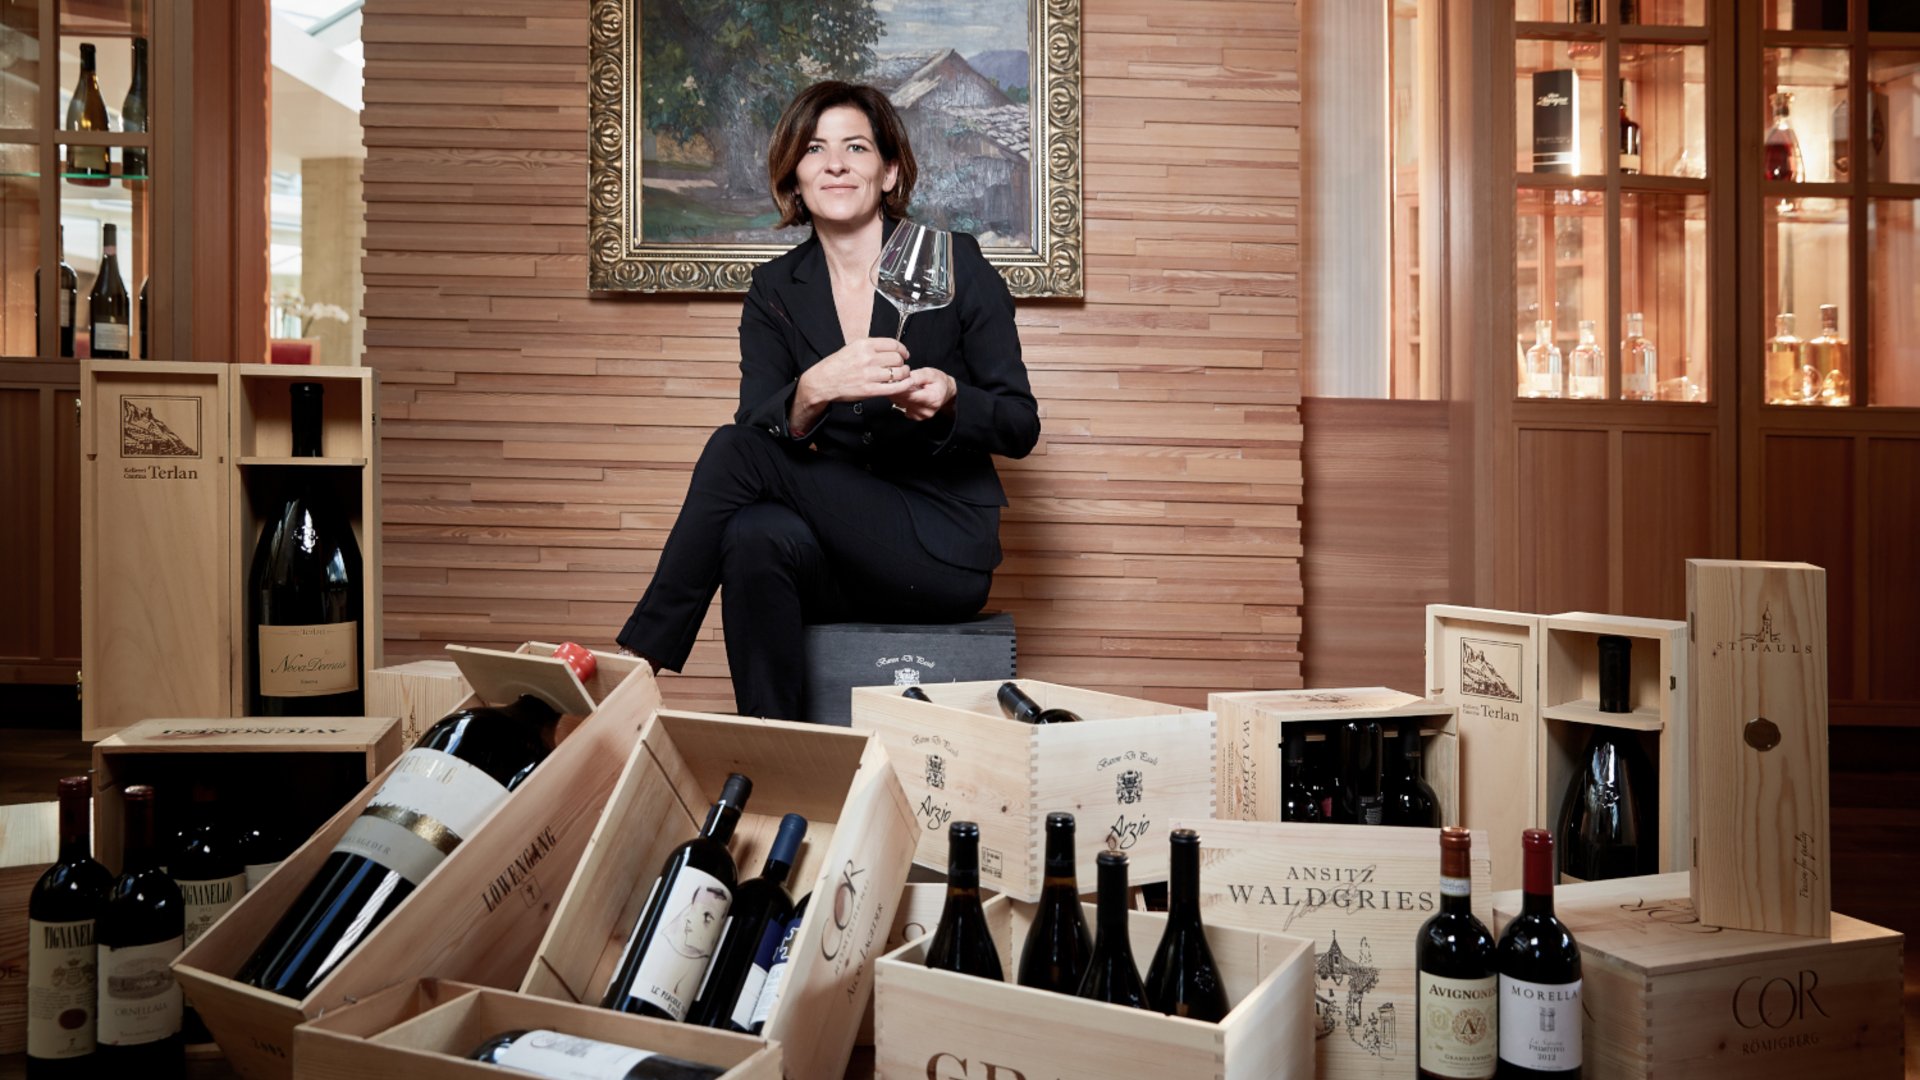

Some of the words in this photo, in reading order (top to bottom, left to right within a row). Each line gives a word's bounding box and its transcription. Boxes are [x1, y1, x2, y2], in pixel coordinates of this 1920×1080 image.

[148, 465, 198, 480] Terlan
[1480, 704, 1519, 722] Terlan
[1242, 720, 1250, 821] WALDGR
[917, 794, 952, 830] Arzio
[1105, 813, 1150, 850] Arzio
[481, 825, 557, 913] LÖWENGANG
[1285, 865, 1375, 883] ANSITZ
[821, 859, 865, 961] COR
[1227, 884, 1435, 912] WALDGRIES
[1428, 983, 1497, 1001] AVIGNONES
[1511, 985, 1579, 1001] MORELLA
[1732, 969, 1831, 1030] COR
[1741, 1031, 1820, 1057] RÖMIGBERG
